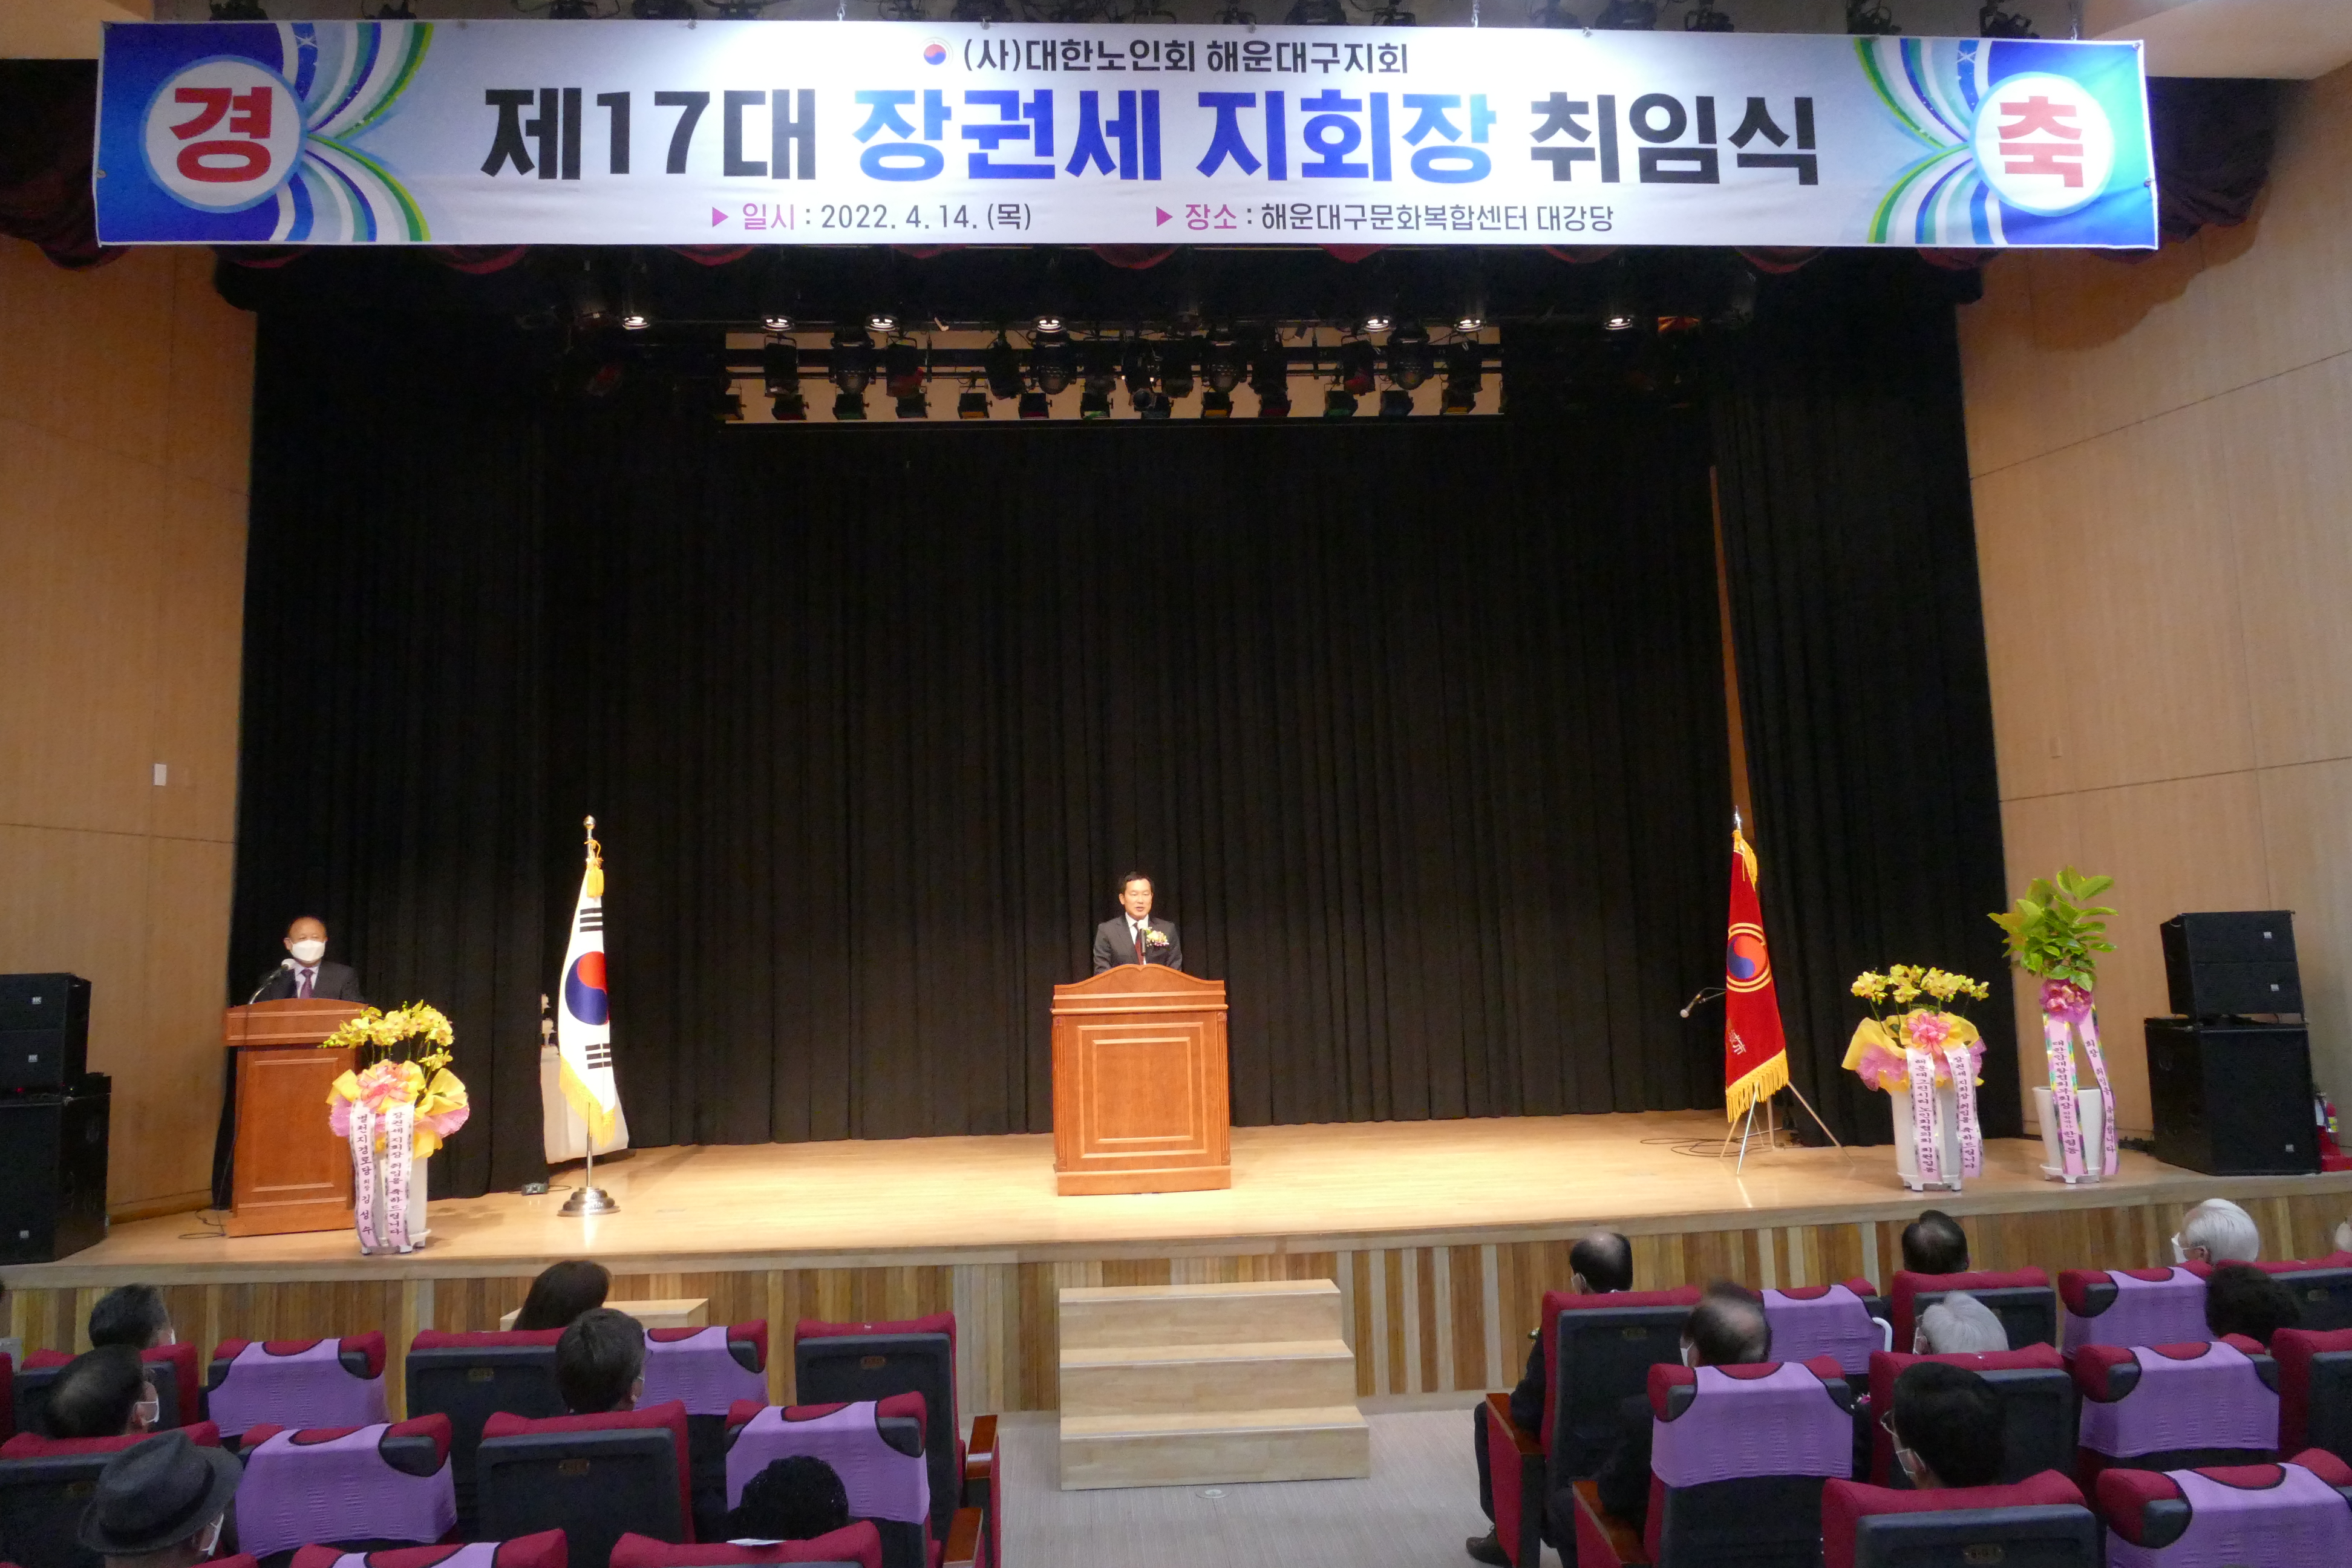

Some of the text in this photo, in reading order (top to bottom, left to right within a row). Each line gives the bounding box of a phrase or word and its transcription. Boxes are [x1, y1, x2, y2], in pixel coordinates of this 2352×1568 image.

[964, 39, 1408, 74] (사)대한노인회 해운대구지회
[169, 86, 273, 183] 경
[481, 87, 1819, 186] 제17대 장권세 지회장 취임식
[1997, 95, 2085, 189] 축
[1261, 203, 1529, 232] 해운대구문화복합센터
[1537, 206, 1615, 233] 대강당
